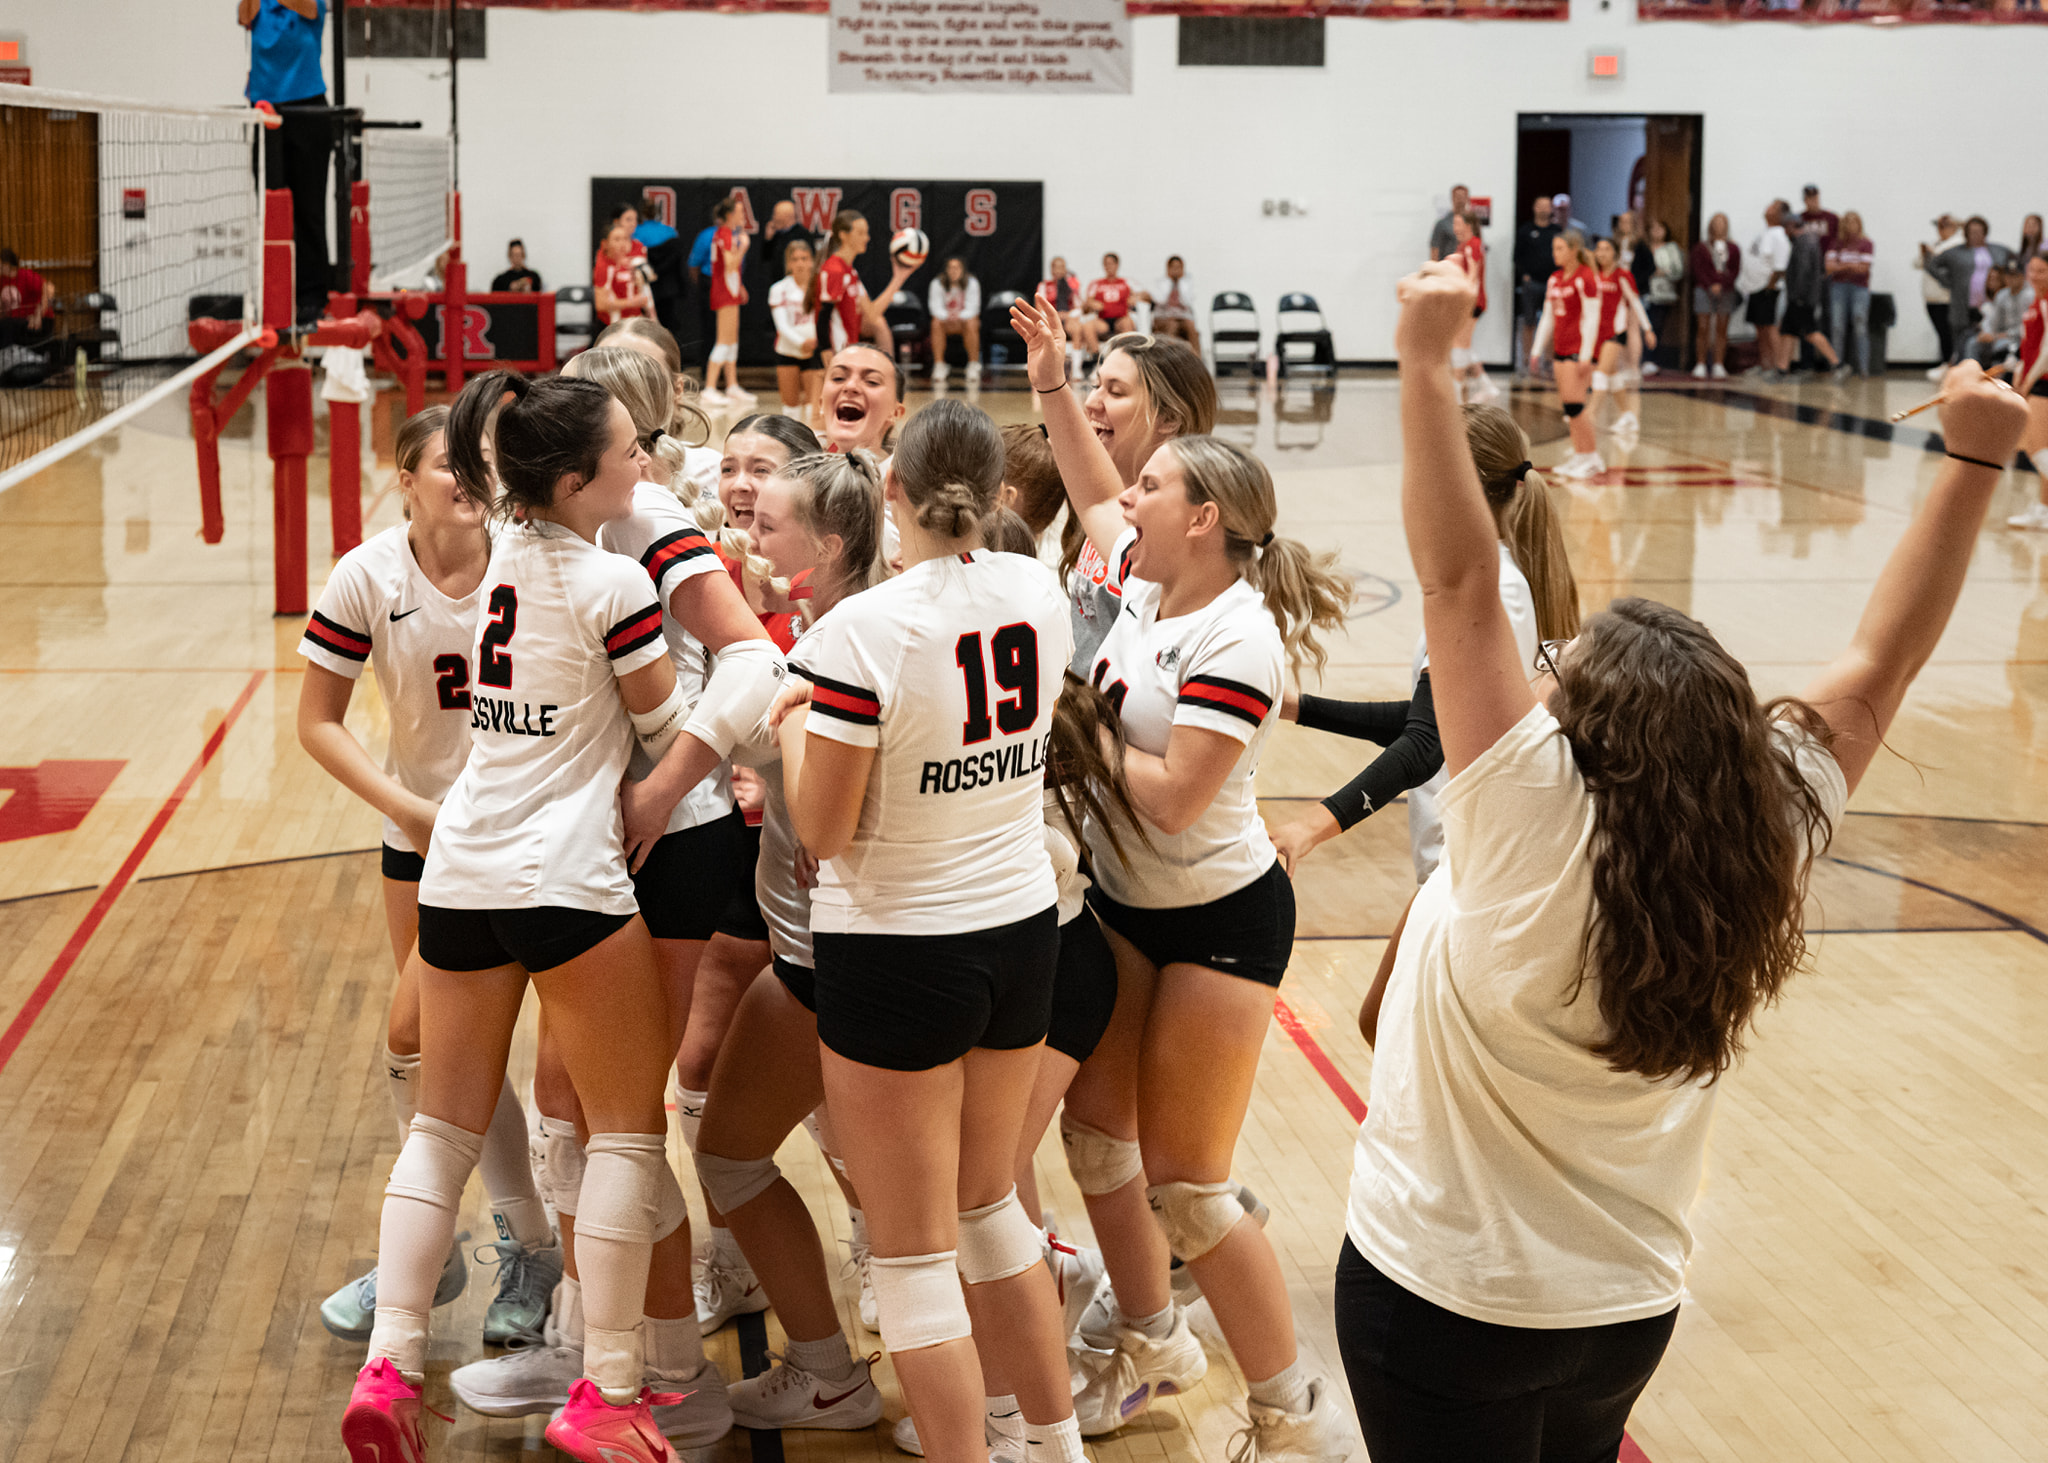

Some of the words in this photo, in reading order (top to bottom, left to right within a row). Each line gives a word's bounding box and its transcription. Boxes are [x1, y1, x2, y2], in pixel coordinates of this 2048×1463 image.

[886, 1, 931, 15] pledge
[838, 17, 875, 32] Fight
[944, 17, 978, 33] fight
[981, 18, 1007, 30] and
[1011, 20, 1038, 30] win
[1041, 19, 1069, 31] this
[864, 34, 891, 46] Roll
[896, 37, 913, 48] up
[917, 36, 940, 46] the
[1022, 34, 1085, 48] Rossville
[901, 53, 924, 63] the
[927, 52, 954, 66] flag
[958, 52, 973, 63] of
[976, 54, 998, 64] red
[1002, 54, 1027, 65] and
[942, 68, 1004, 81] Rossville
[478, 583, 518, 690] 2
[955, 621, 1039, 746] 19
